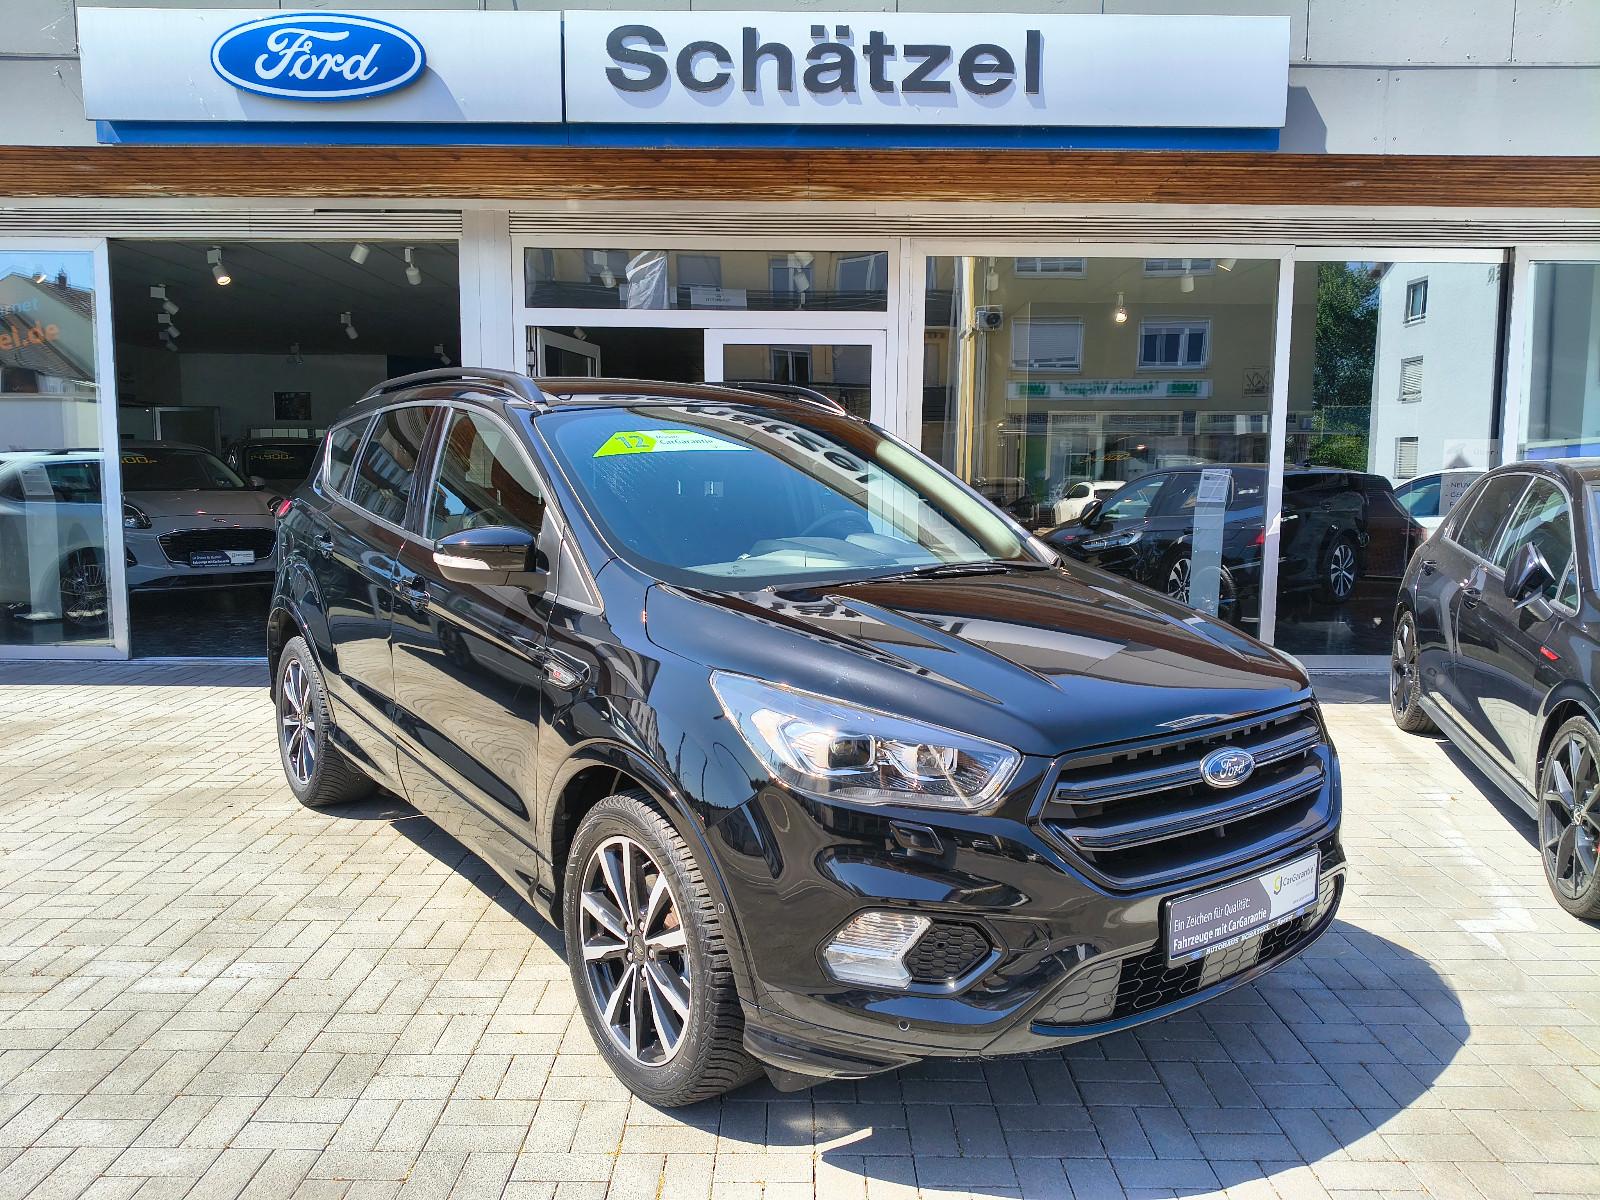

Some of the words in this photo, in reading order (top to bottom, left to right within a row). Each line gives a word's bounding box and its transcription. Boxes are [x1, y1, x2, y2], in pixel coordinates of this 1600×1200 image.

[254, 27, 382, 82] Ford
[604, 24, 1042, 96] Schätzel
[615, 435, 650, 449] 12
[1219, 757, 1246, 779] Ford
[1173, 919, 1185, 933] Ein
[1186, 911, 1213, 929] Zeichen
[1213, 906, 1224, 920] für
[1173, 929, 1213, 952] Fahrzeuge
[1214, 922, 1228, 937] mit
[1228, 907, 1267, 932] CarGarantie
